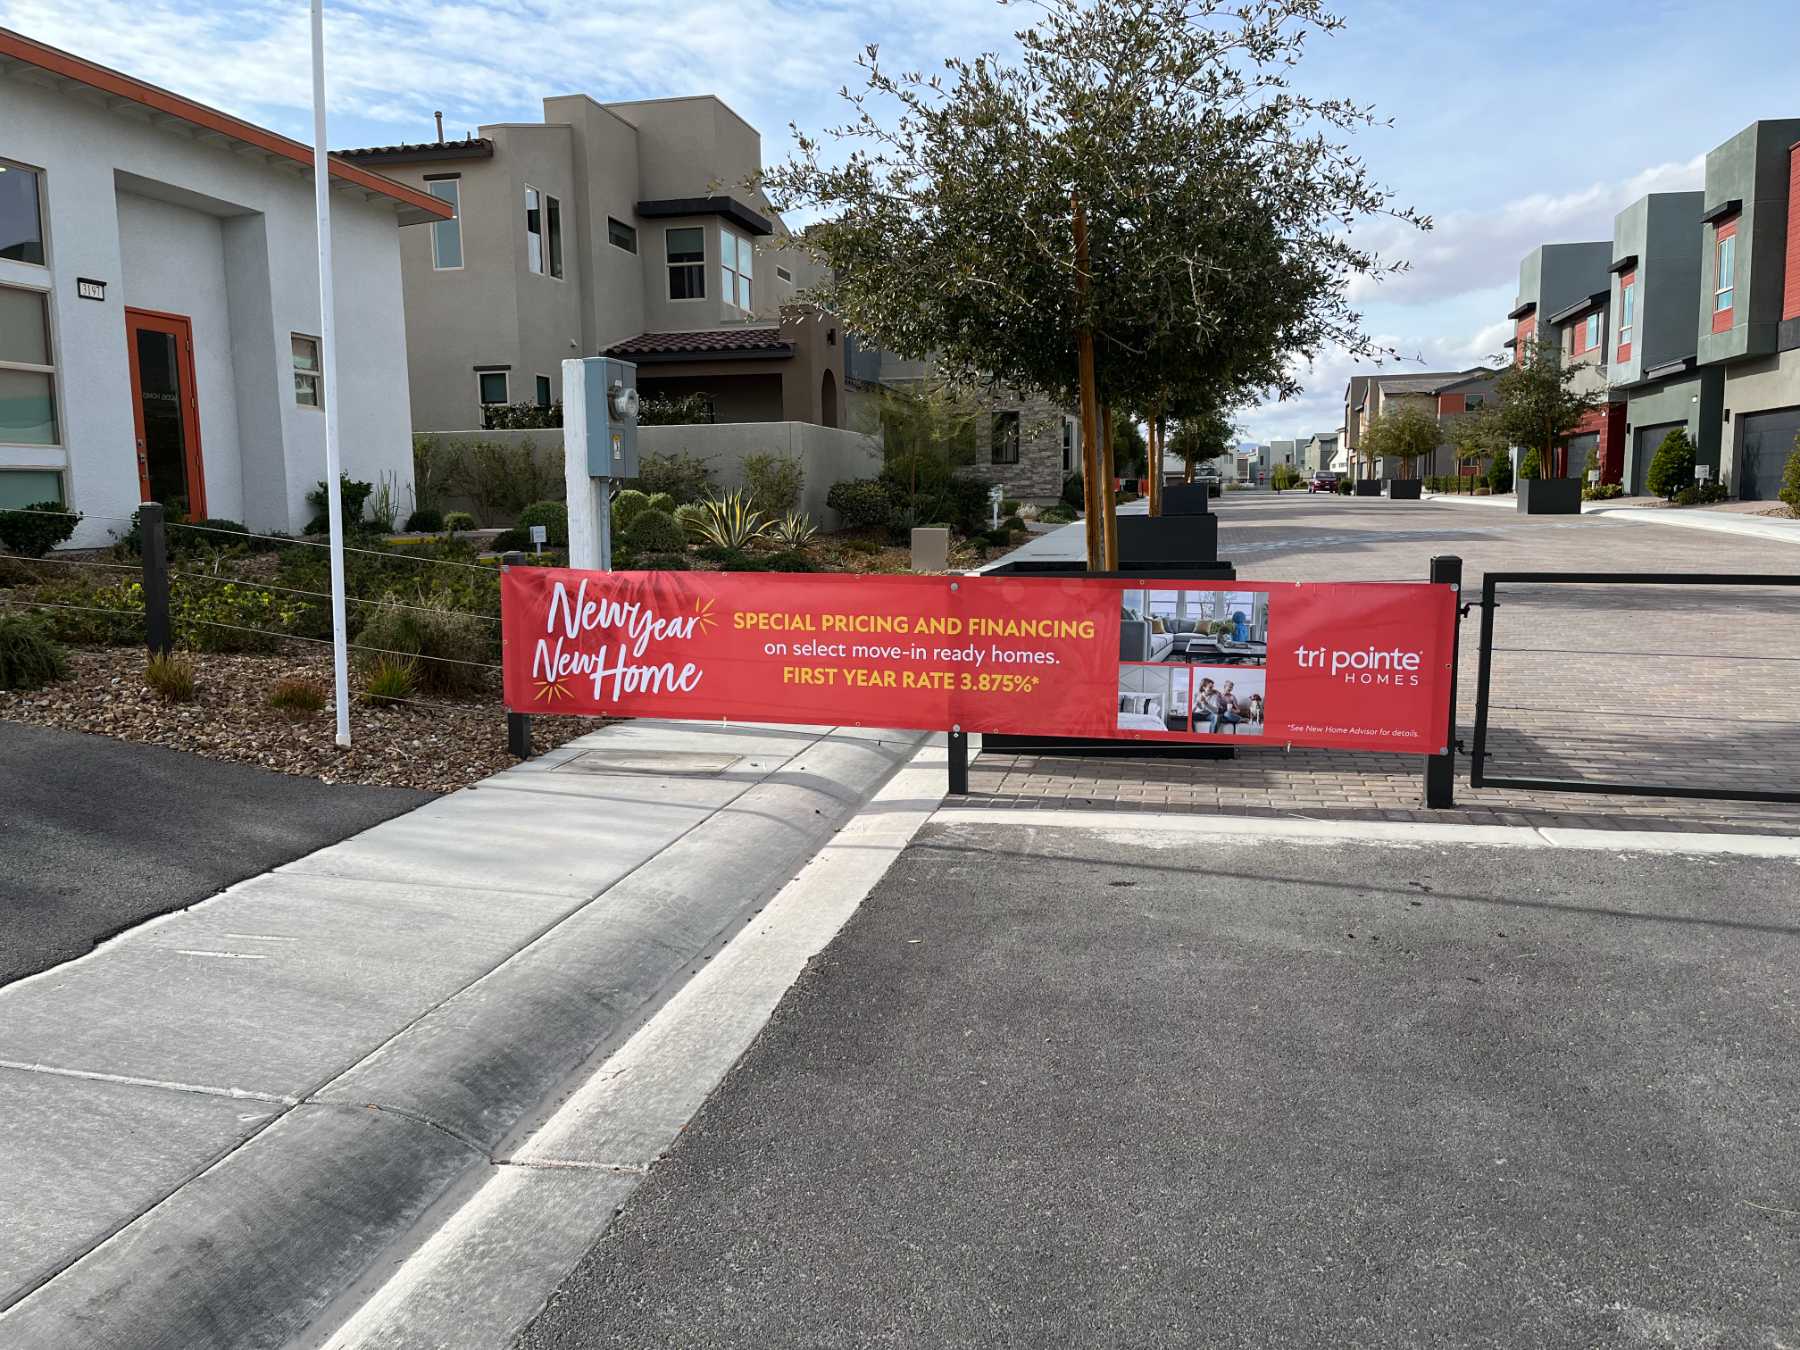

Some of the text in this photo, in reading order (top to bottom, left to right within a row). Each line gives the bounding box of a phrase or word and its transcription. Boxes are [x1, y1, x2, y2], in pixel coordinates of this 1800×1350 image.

[81, 283, 100, 297] 3197
[546, 578, 636, 640] New
[733, 612, 1095, 639] SPECIAL PRICING AND FINANCING
[764, 639, 1060, 667] on select move-in ready homes.
[1295, 645, 1420, 676] tri pointe
[532, 636, 703, 702] New Home
[783, 666, 838, 685] FIRST
[843, 669, 897, 688] YEAR
[902, 671, 954, 690] RATE
[1345, 673, 1418, 685] HOMES
[1306, 725, 1323, 733] New
[1325, 726, 1348, 735] Home
[1349, 727, 1378, 736] Advisor
[1379, 728, 1390, 737] for
